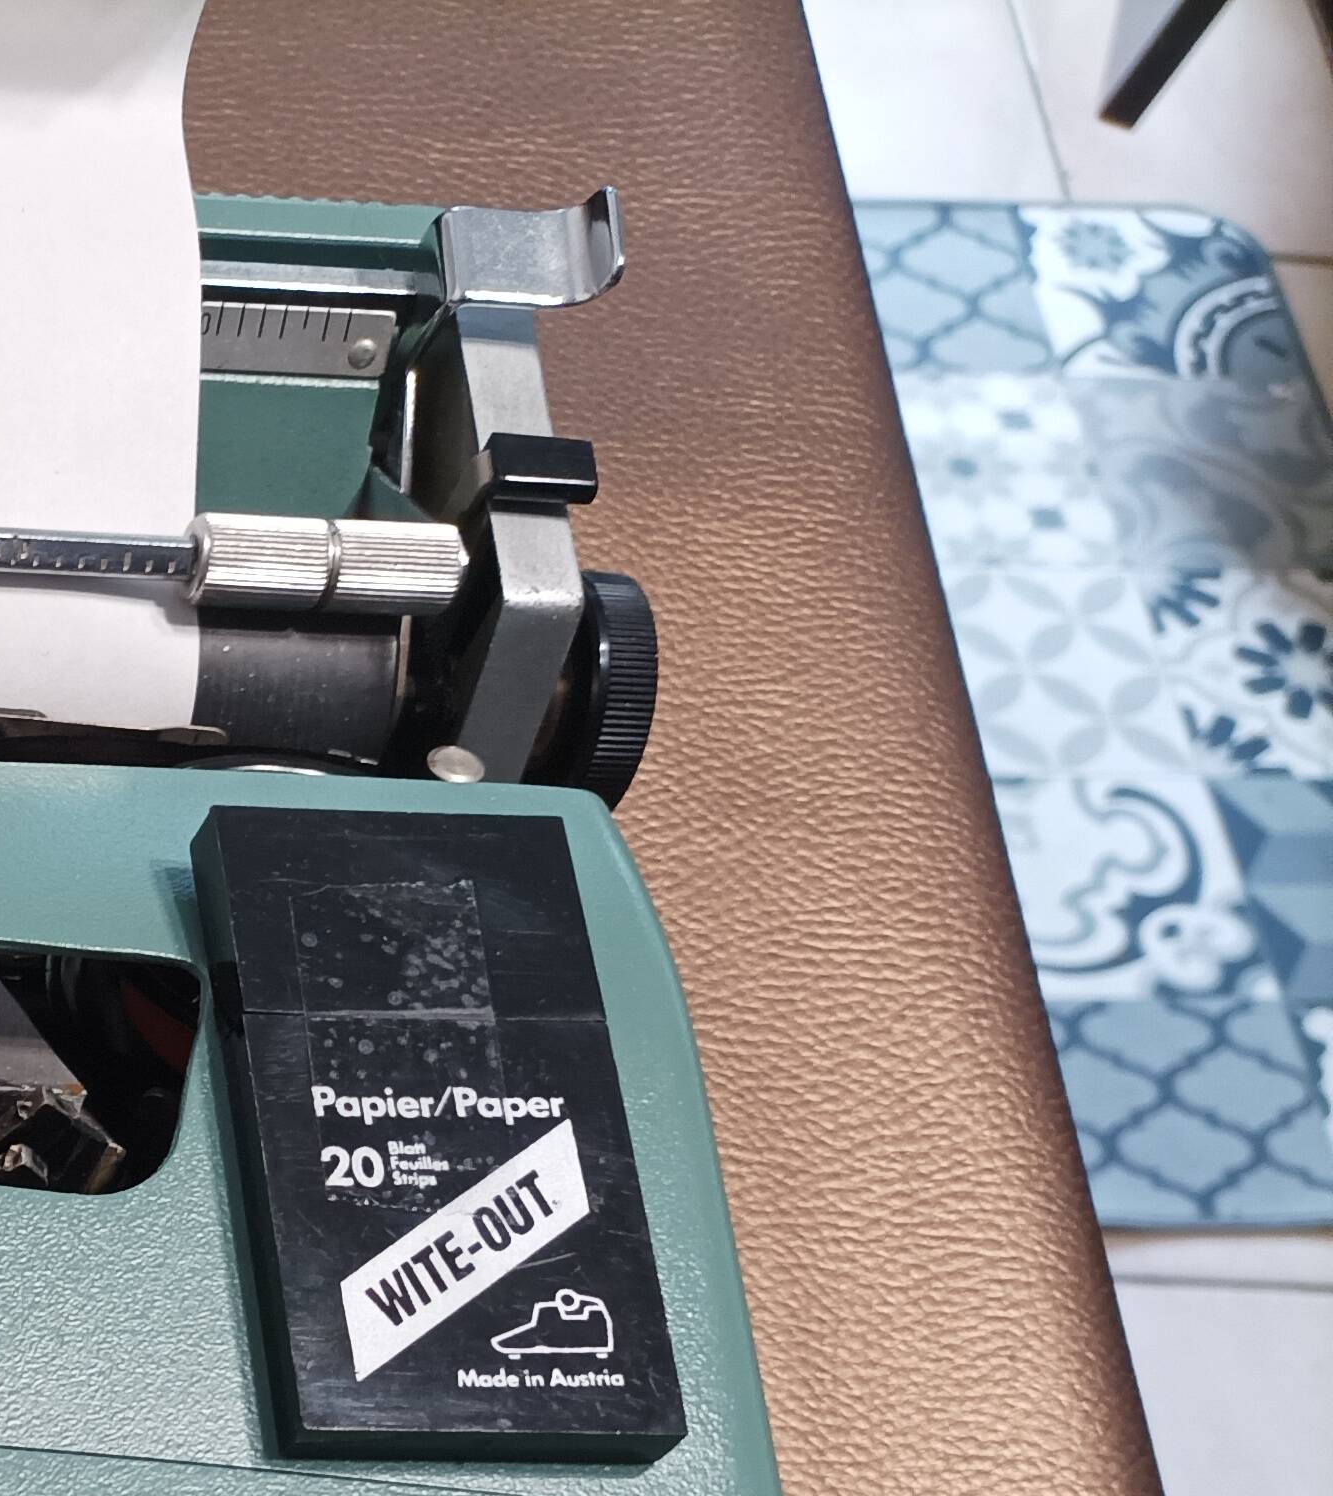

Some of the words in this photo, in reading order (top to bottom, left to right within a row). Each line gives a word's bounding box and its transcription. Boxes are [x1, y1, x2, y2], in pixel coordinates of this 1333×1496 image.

[311, 1085, 564, 1126] Papier/Paper
[320, 1146, 385, 1188] 20
[365, 1169, 554, 1327] WITE-OUT
[457, 1368, 520, 1388] Made
[524, 1368, 545, 1388] in
[549, 1367, 625, 1388] Austria
